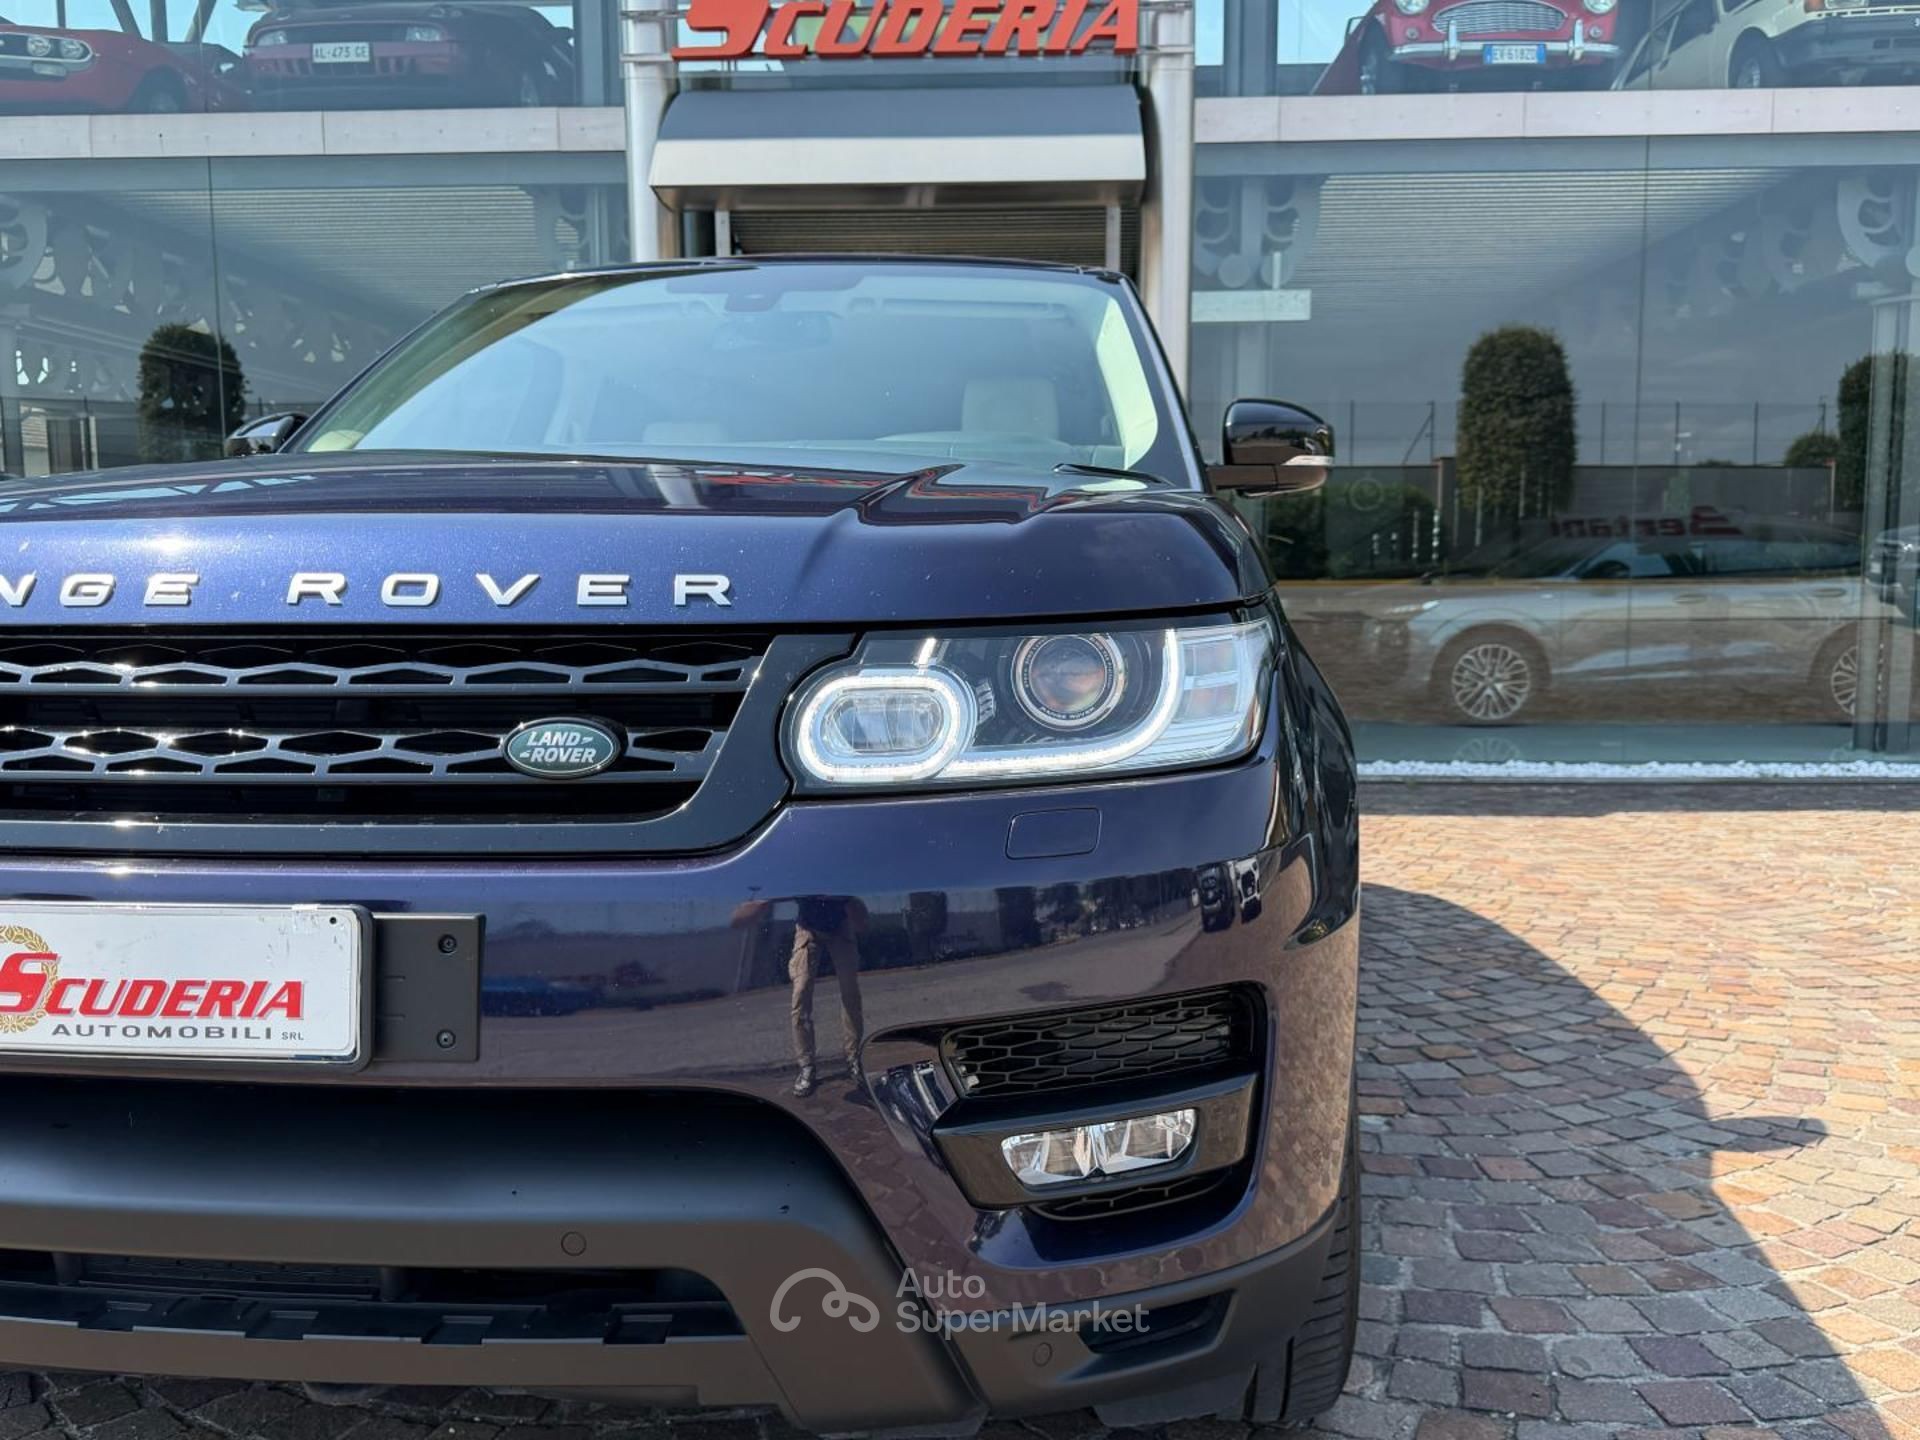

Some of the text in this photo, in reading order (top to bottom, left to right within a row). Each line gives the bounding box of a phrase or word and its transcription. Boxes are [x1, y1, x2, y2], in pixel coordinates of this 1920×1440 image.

[672, 0, 1139, 60] SCUDERIA
[286, 572, 732, 607] ROVER
[527, 731, 582, 747] LAND
[530, 747, 597, 763] ROVER
[0, 952, 304, 1021] SCUDERIA
[52, 1023, 304, 1041] AUTOMOBILI SRL
